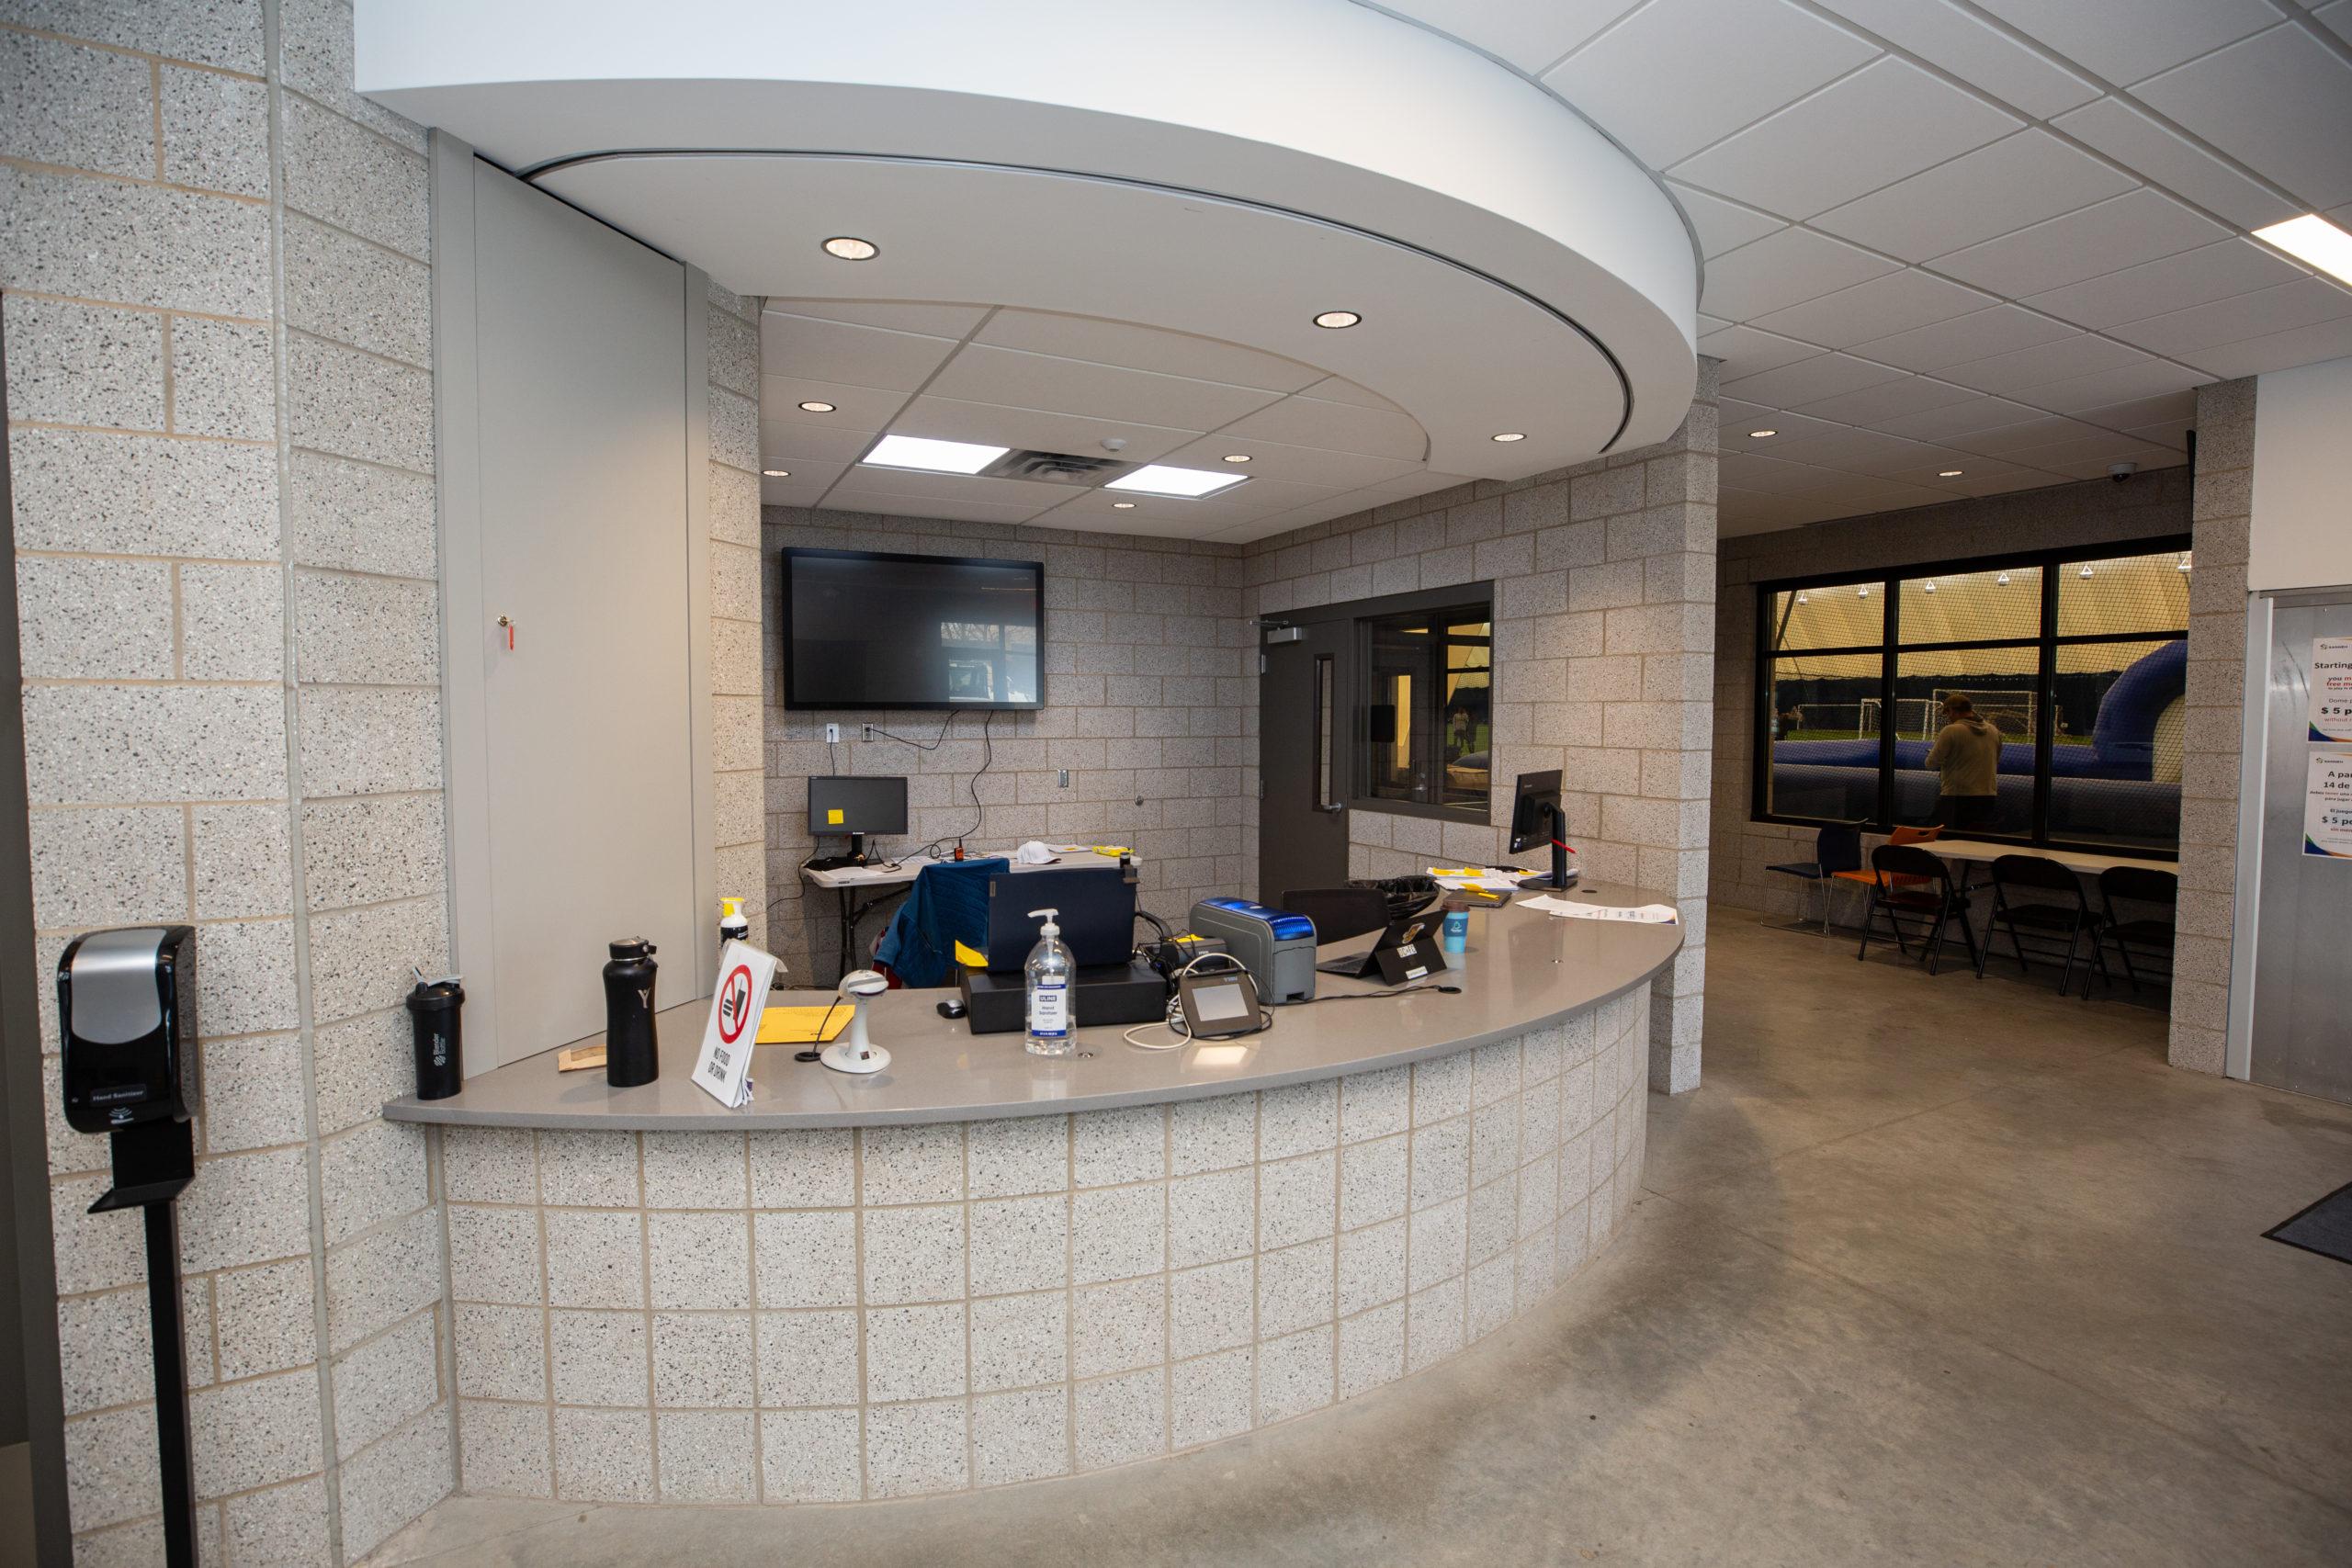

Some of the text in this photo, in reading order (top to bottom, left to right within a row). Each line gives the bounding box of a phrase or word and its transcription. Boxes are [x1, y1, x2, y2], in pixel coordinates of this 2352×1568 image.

[2321, 706, 2329, 715] $
[2322, 816, 2329, 824] $
[714, 1047, 731, 1066] NO FOOD
[707, 1061, 728, 1084] OR DRINK
